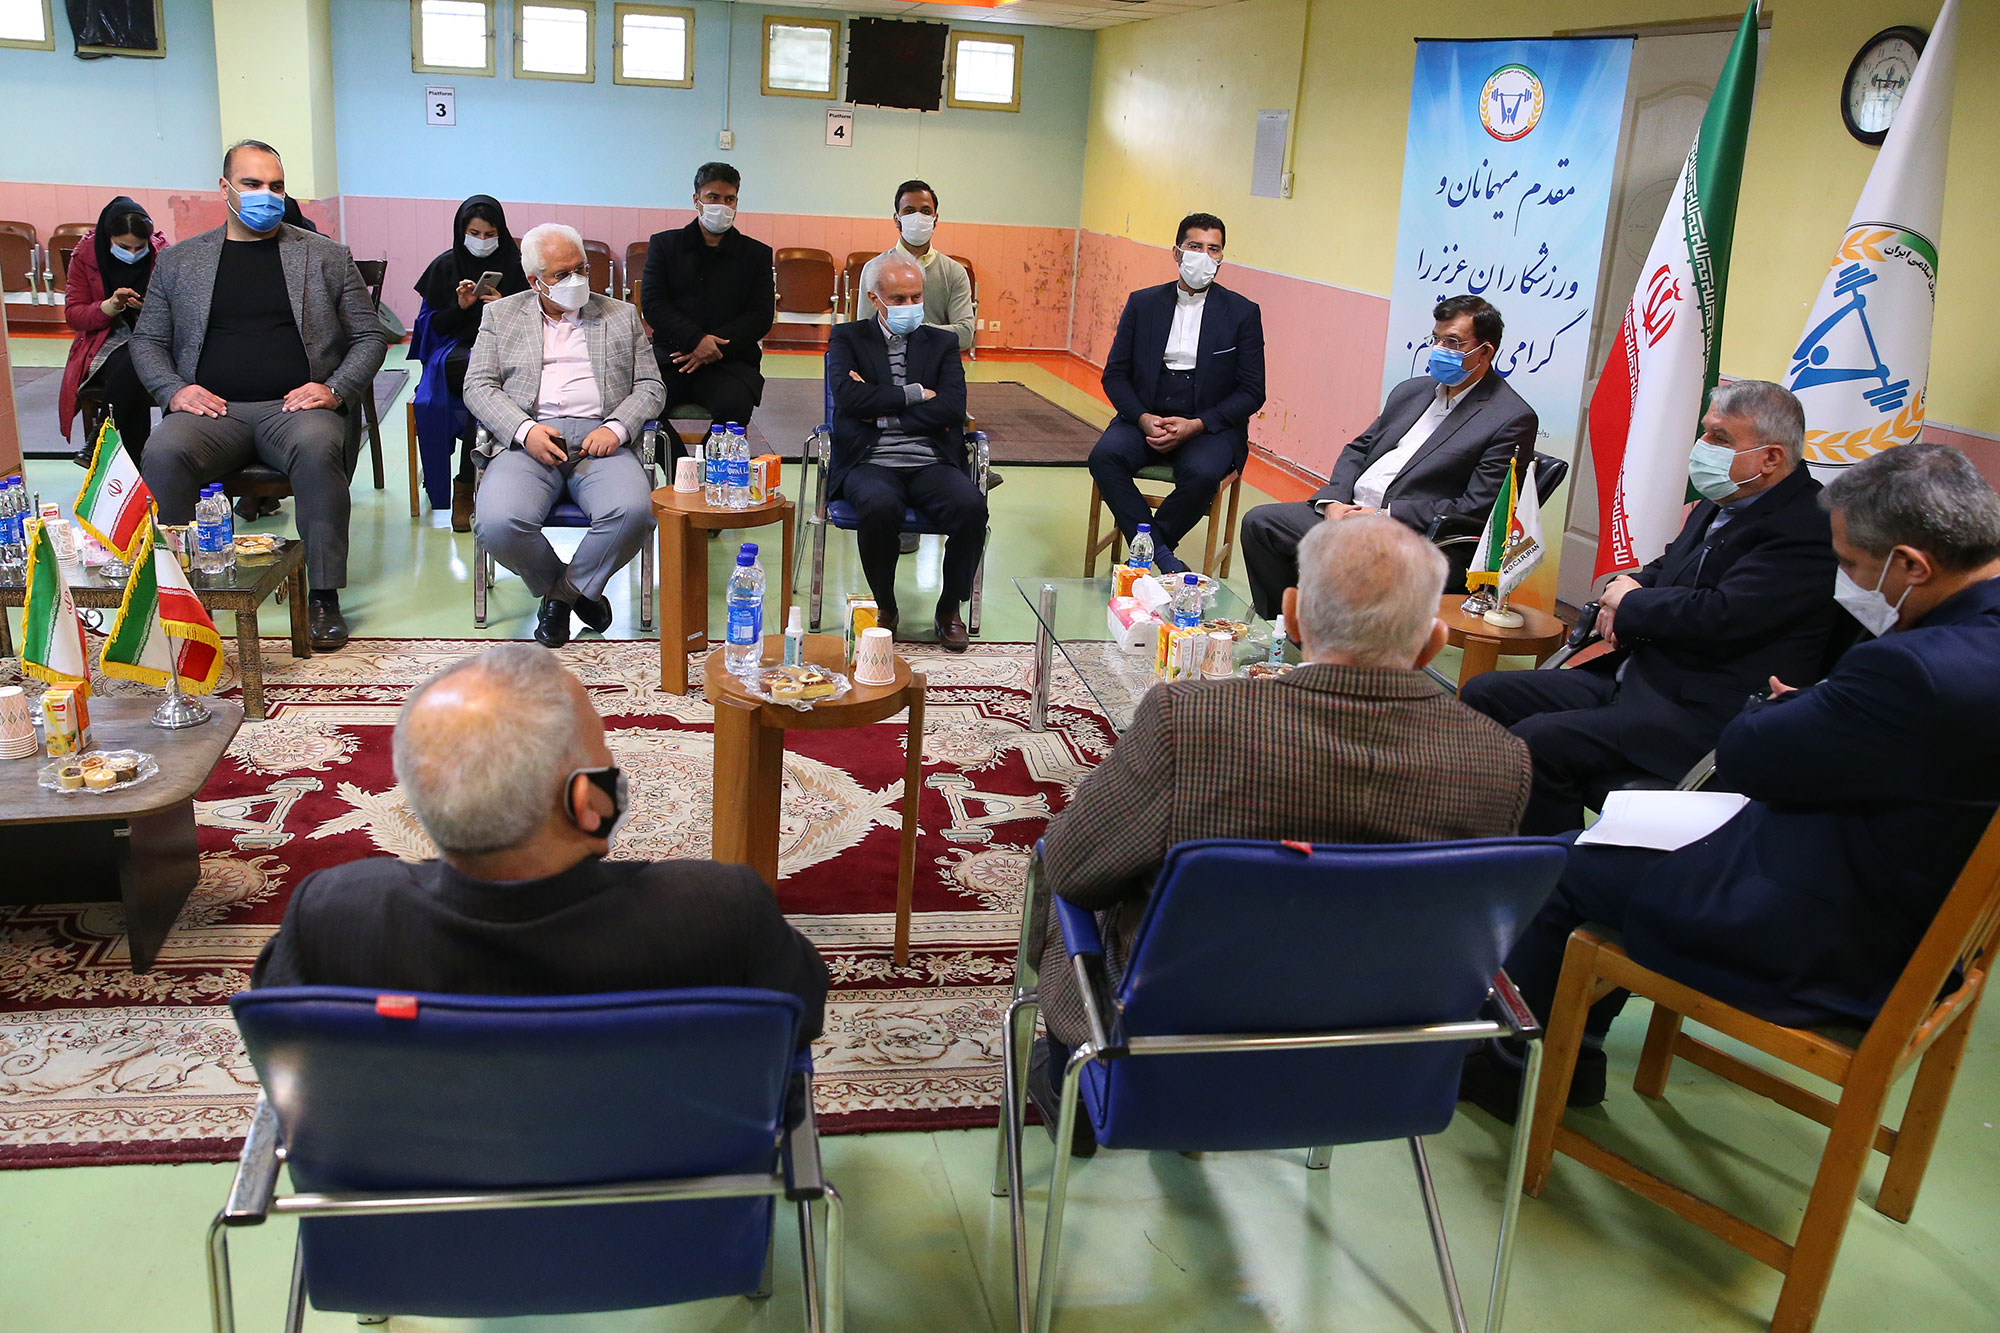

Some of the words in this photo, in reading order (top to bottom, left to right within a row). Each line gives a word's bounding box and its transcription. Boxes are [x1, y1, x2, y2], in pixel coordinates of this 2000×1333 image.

[435, 103, 447, 117] 3
[833, 125, 845, 138] 4
[1435, 175, 1448, 196] و
[1513, 158, 1576, 237] مقدم
[1883, 245, 1912, 260] ایران
[1907, 257, 1934, 281] اسلامی
